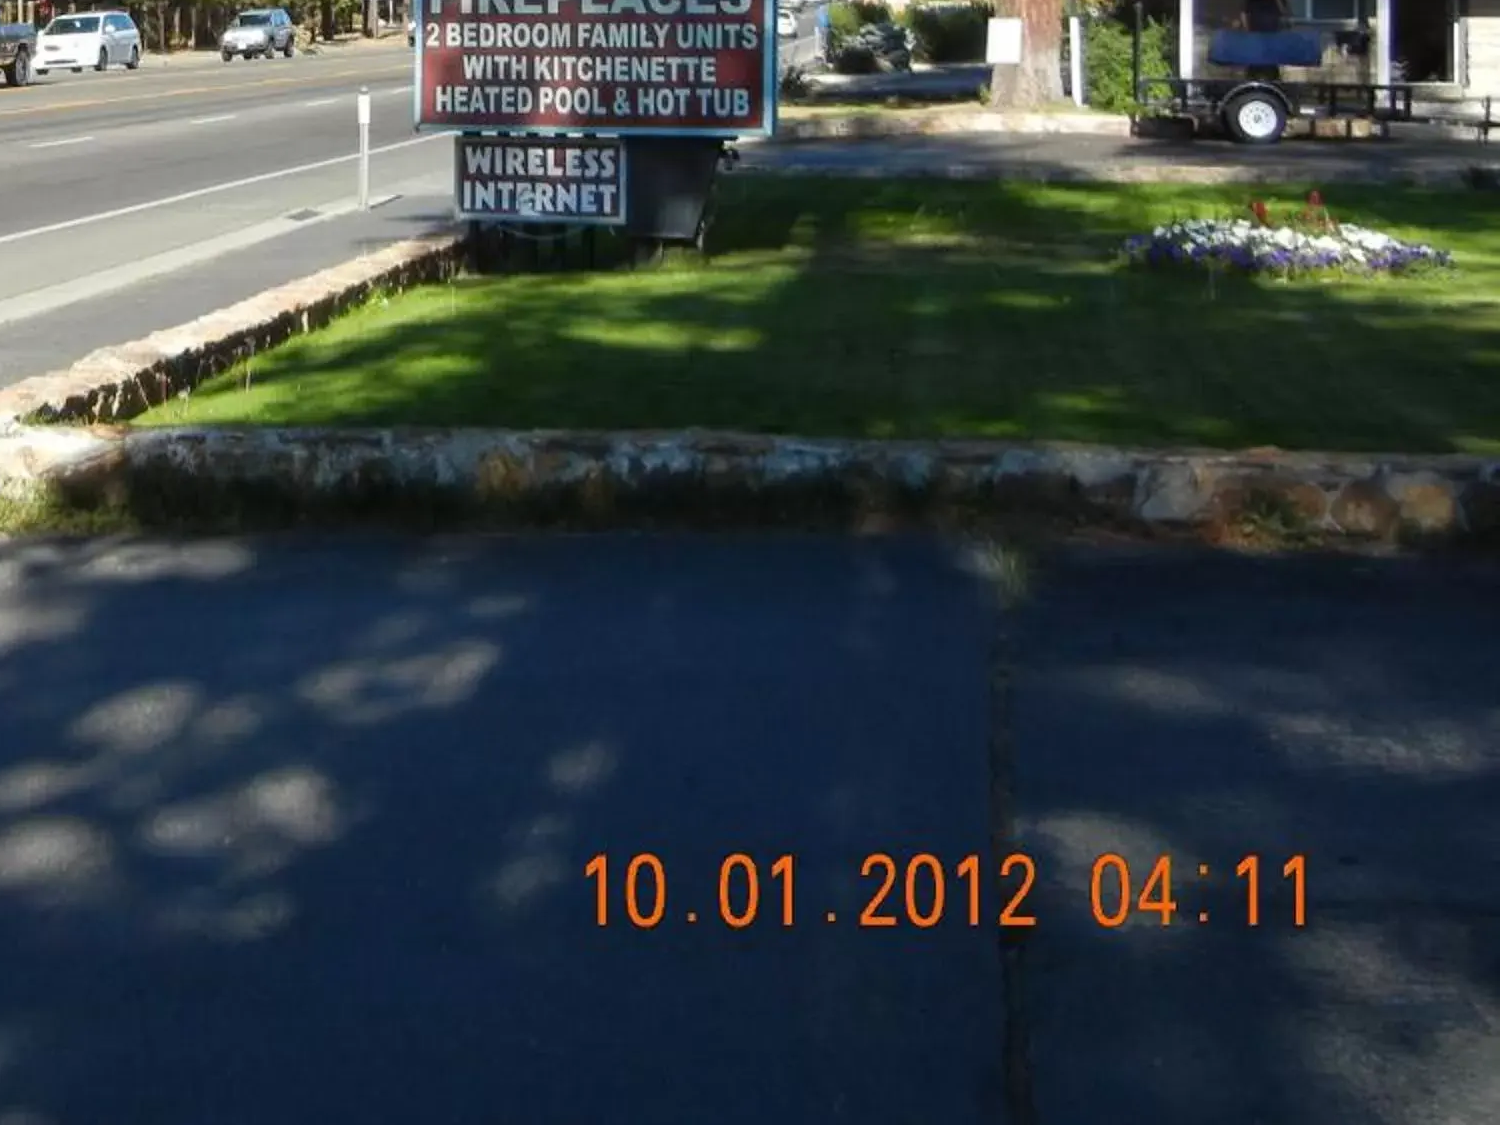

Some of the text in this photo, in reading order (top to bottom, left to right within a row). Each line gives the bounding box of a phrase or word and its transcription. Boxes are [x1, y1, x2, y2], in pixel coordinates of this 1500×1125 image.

[425, 23, 758, 50] 2 BEDROOM FAMILY UNITS
[462, 55, 717, 84] WITH KITCHENETTE
[435, 86, 750, 117] HEATED POOL & HOT TUB
[464, 146, 617, 178] WIRELESS
[462, 180, 617, 214] INTERNET
